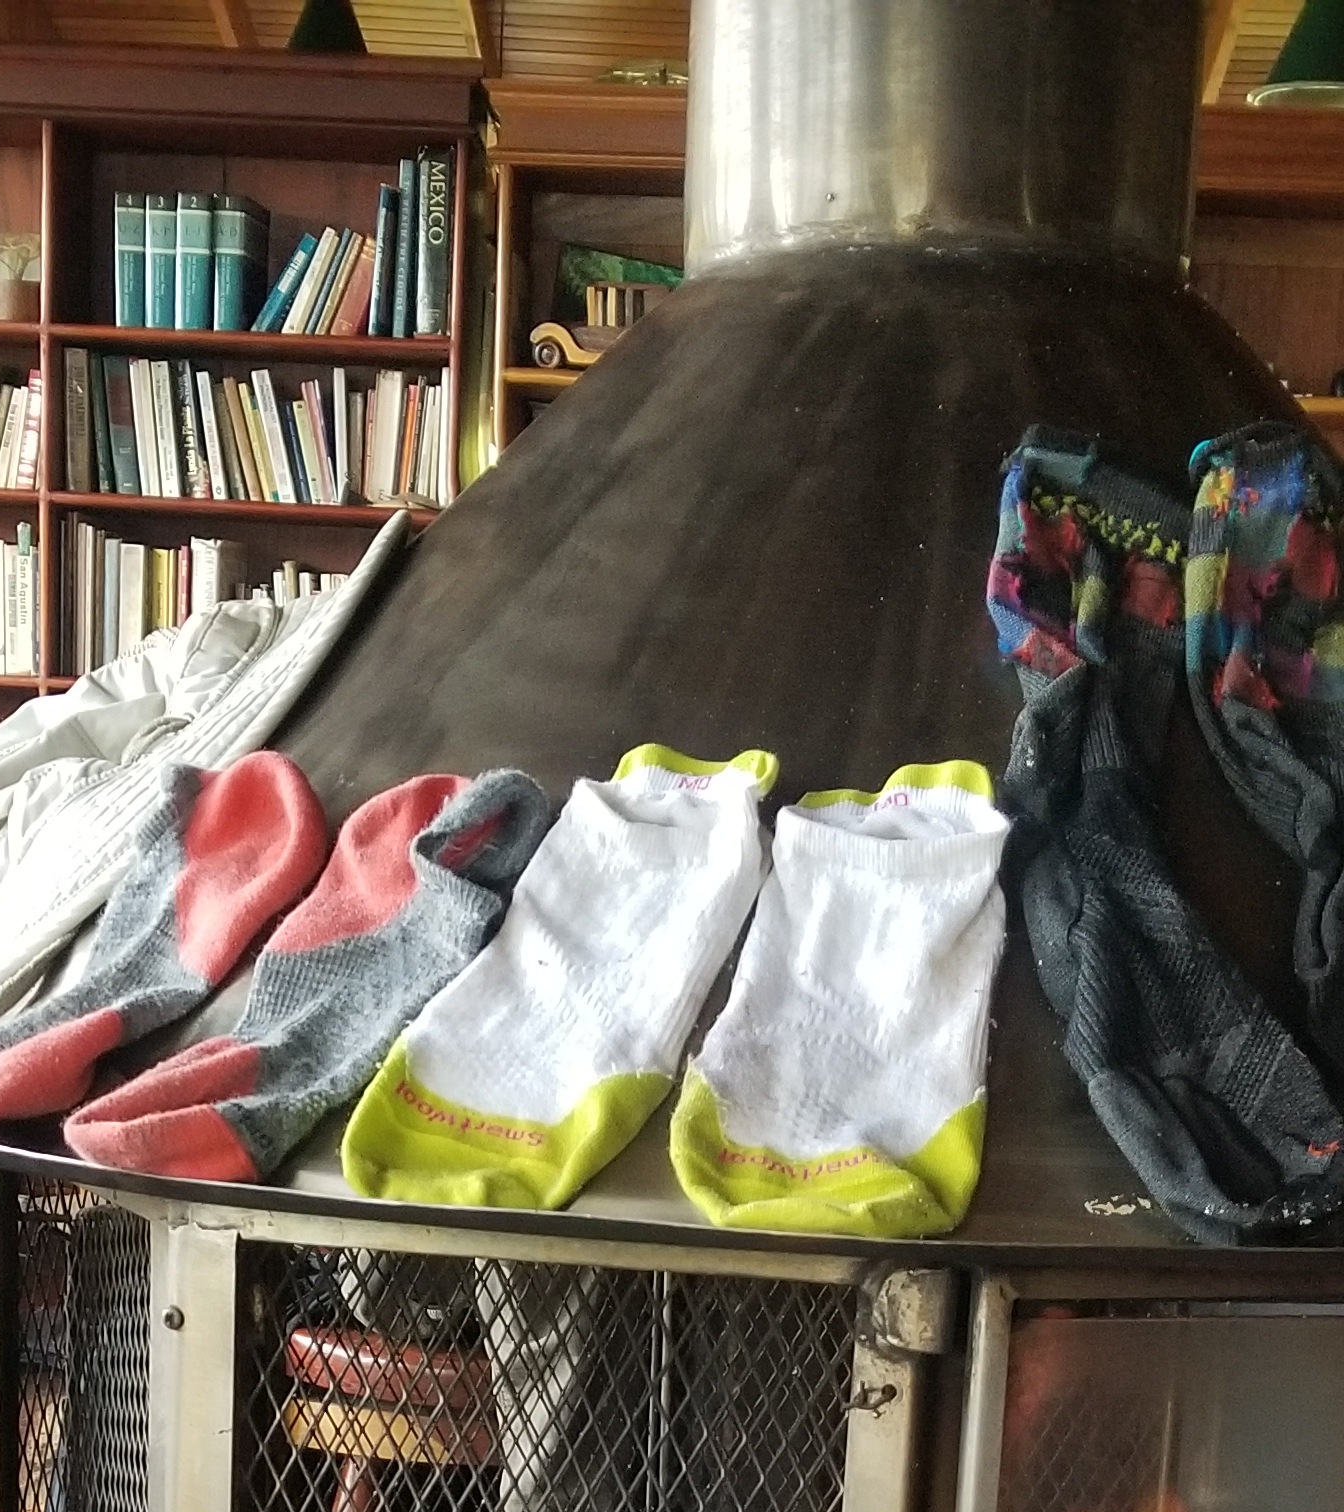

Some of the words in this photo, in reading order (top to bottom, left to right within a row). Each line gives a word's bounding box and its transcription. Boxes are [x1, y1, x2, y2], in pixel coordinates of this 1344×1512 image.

[126, 194, 132, 206] 4
[157, 196, 164, 208] 3
[191, 196, 198, 208] 2
[225, 197, 230, 208] 1
[428, 160, 446, 246] MEXICO
[19, 557, 29, 579] San
